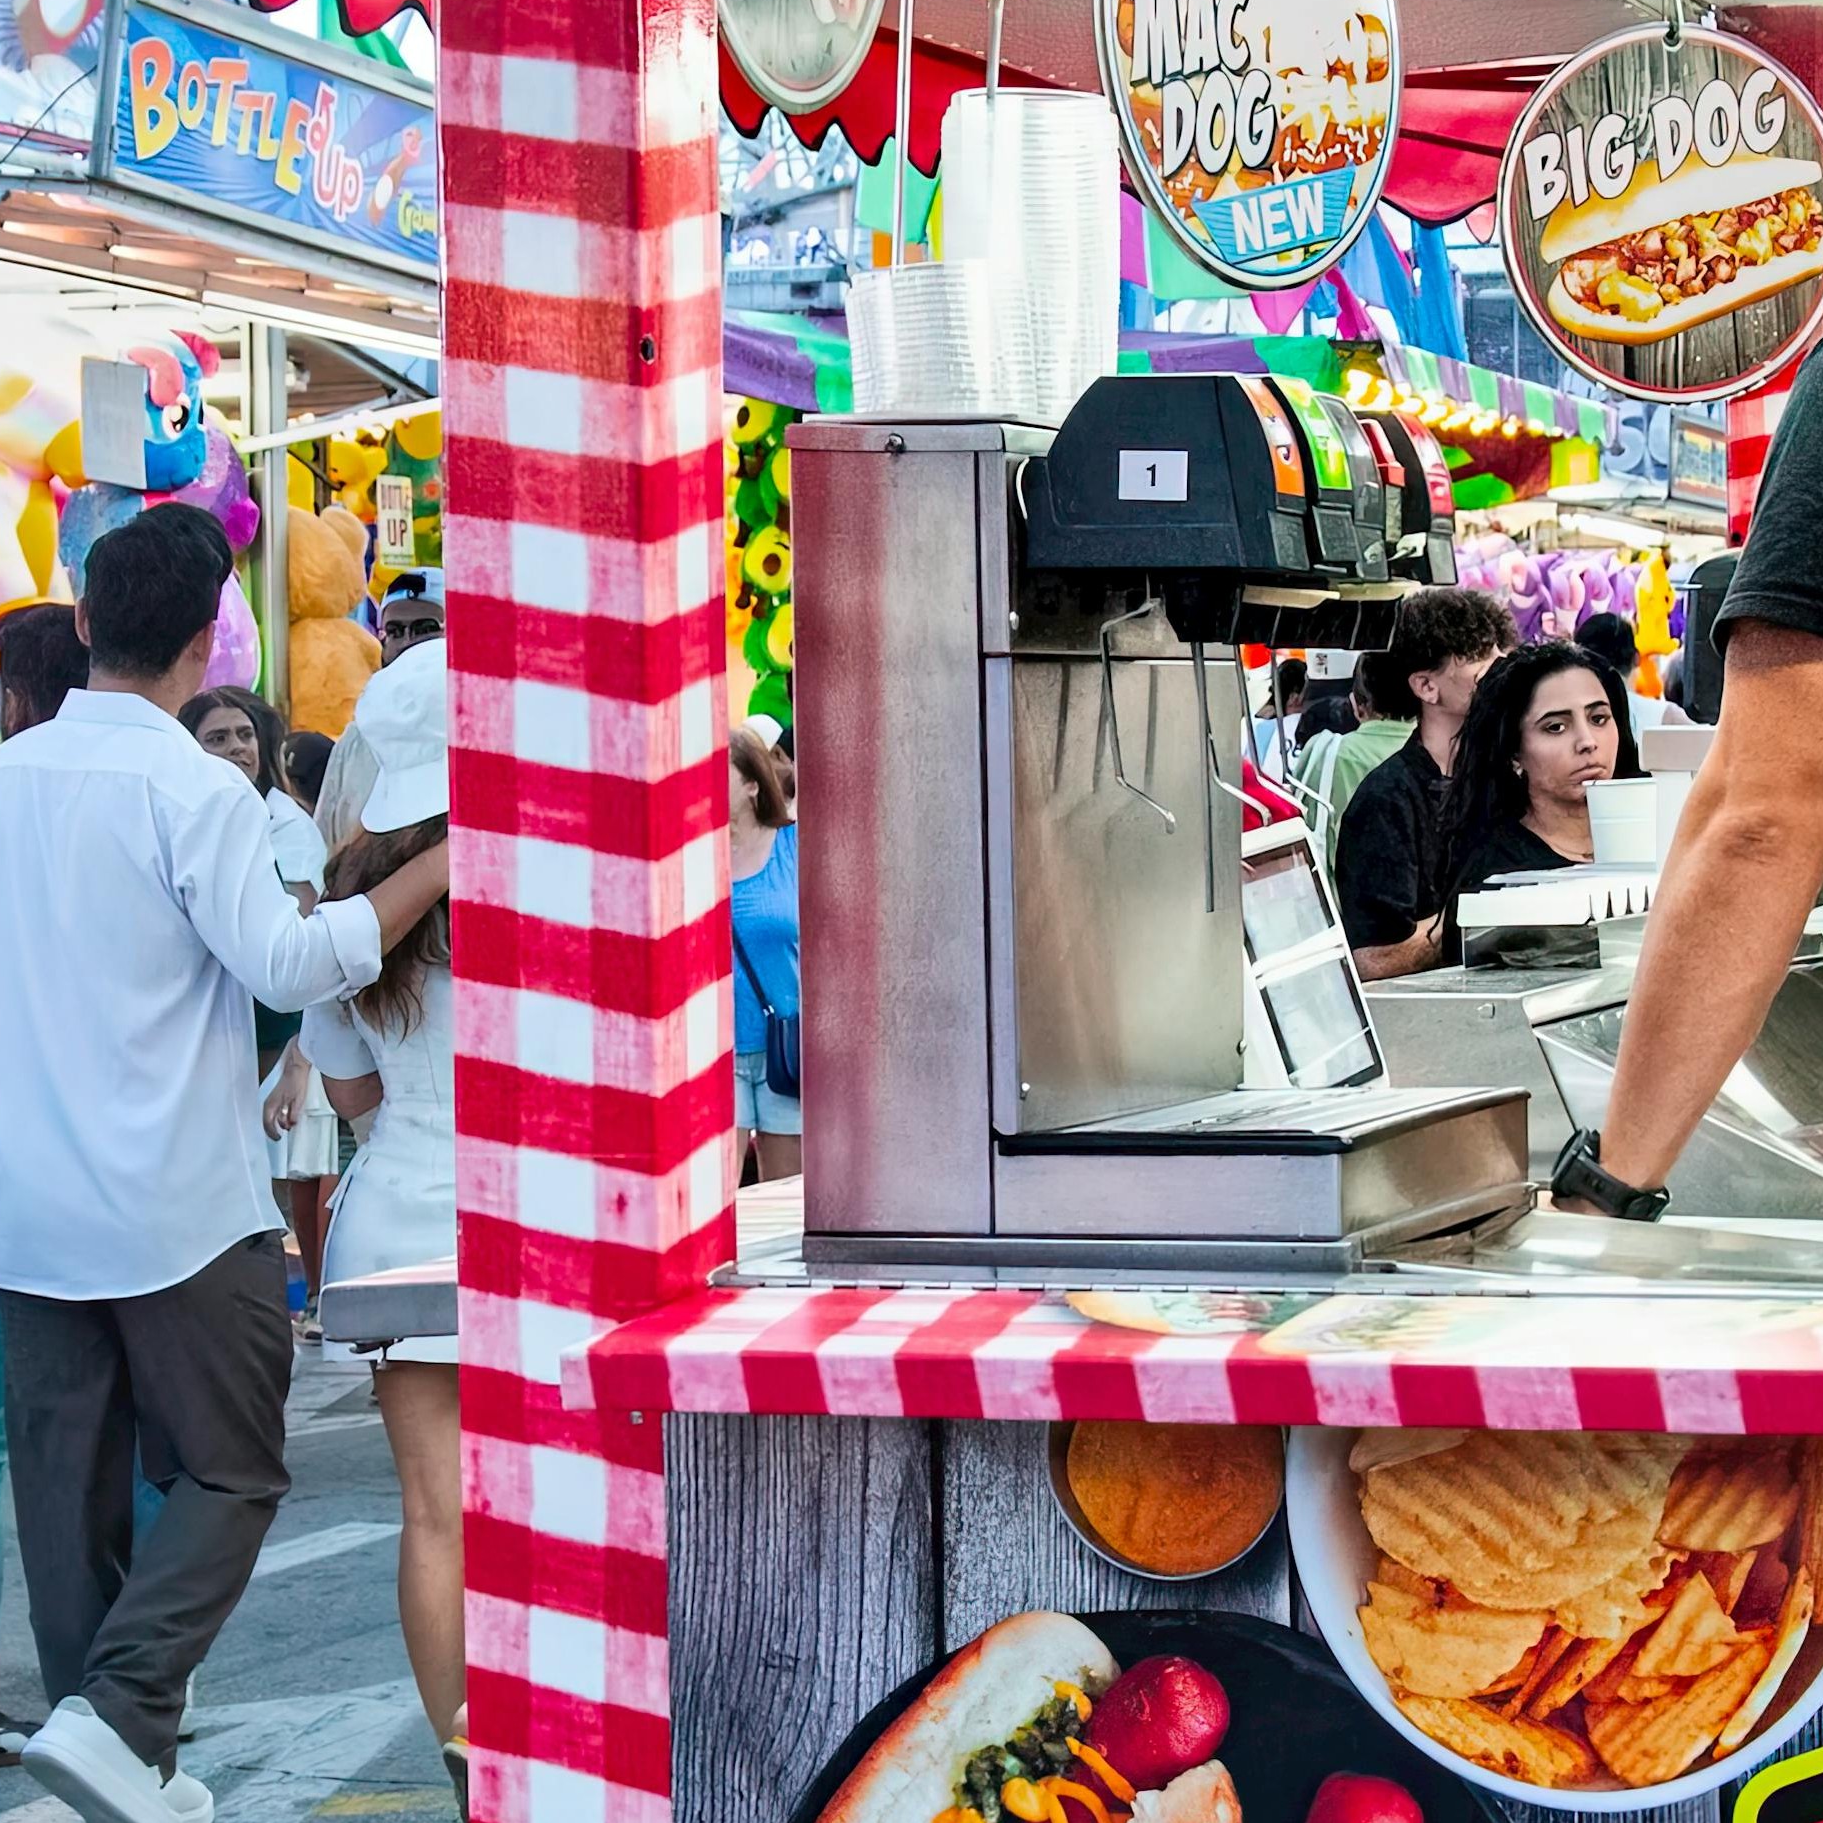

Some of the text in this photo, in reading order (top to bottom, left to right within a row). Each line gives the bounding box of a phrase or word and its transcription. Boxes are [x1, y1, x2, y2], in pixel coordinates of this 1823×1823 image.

[128, 34, 365, 224] BOTTLE Up
[1163, 69, 1277, 177] DOG
[1523, 67, 1786, 221] BIG DOG
[1230, 181, 1325, 255] NEW
[1145, 462, 1158, 487] 1
[387, 519, 408, 547] UP
